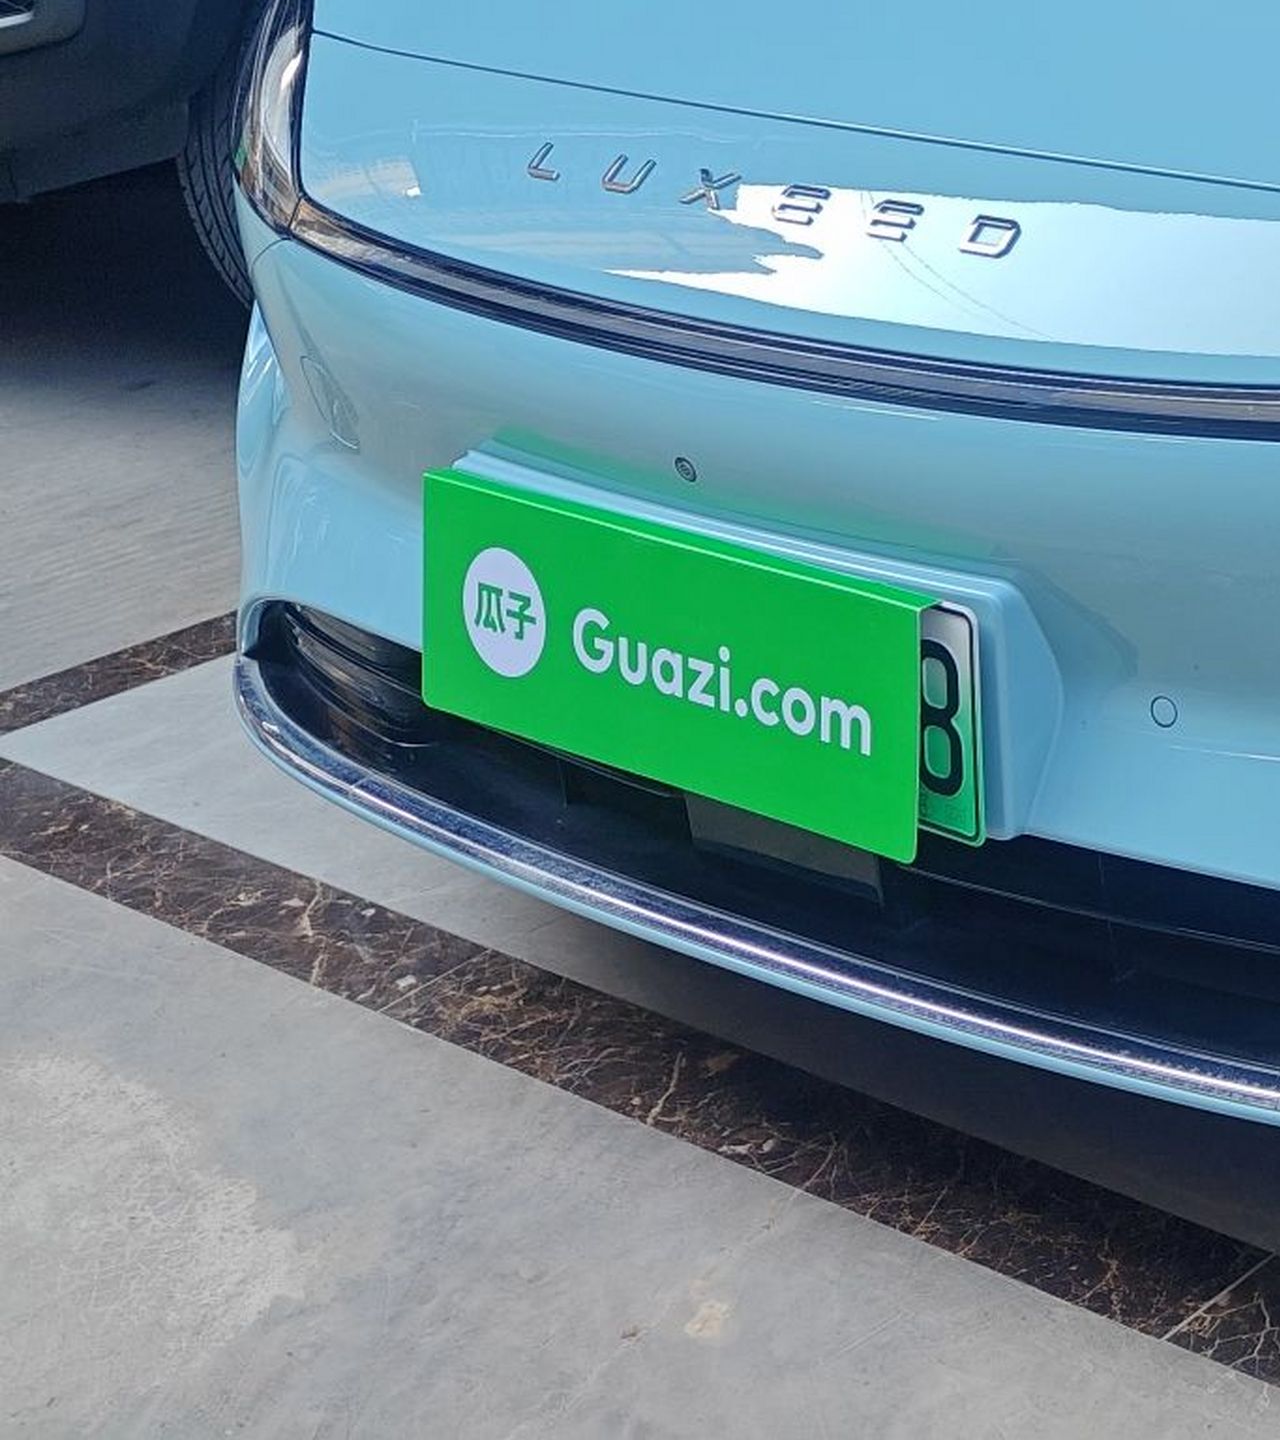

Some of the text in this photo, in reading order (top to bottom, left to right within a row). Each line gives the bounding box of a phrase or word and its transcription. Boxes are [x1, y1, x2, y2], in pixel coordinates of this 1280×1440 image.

[526, 141, 1022, 259] LUXEED
[473, 581, 537, 641] 瓜子
[572, 607, 872, 757] Guazi.com
